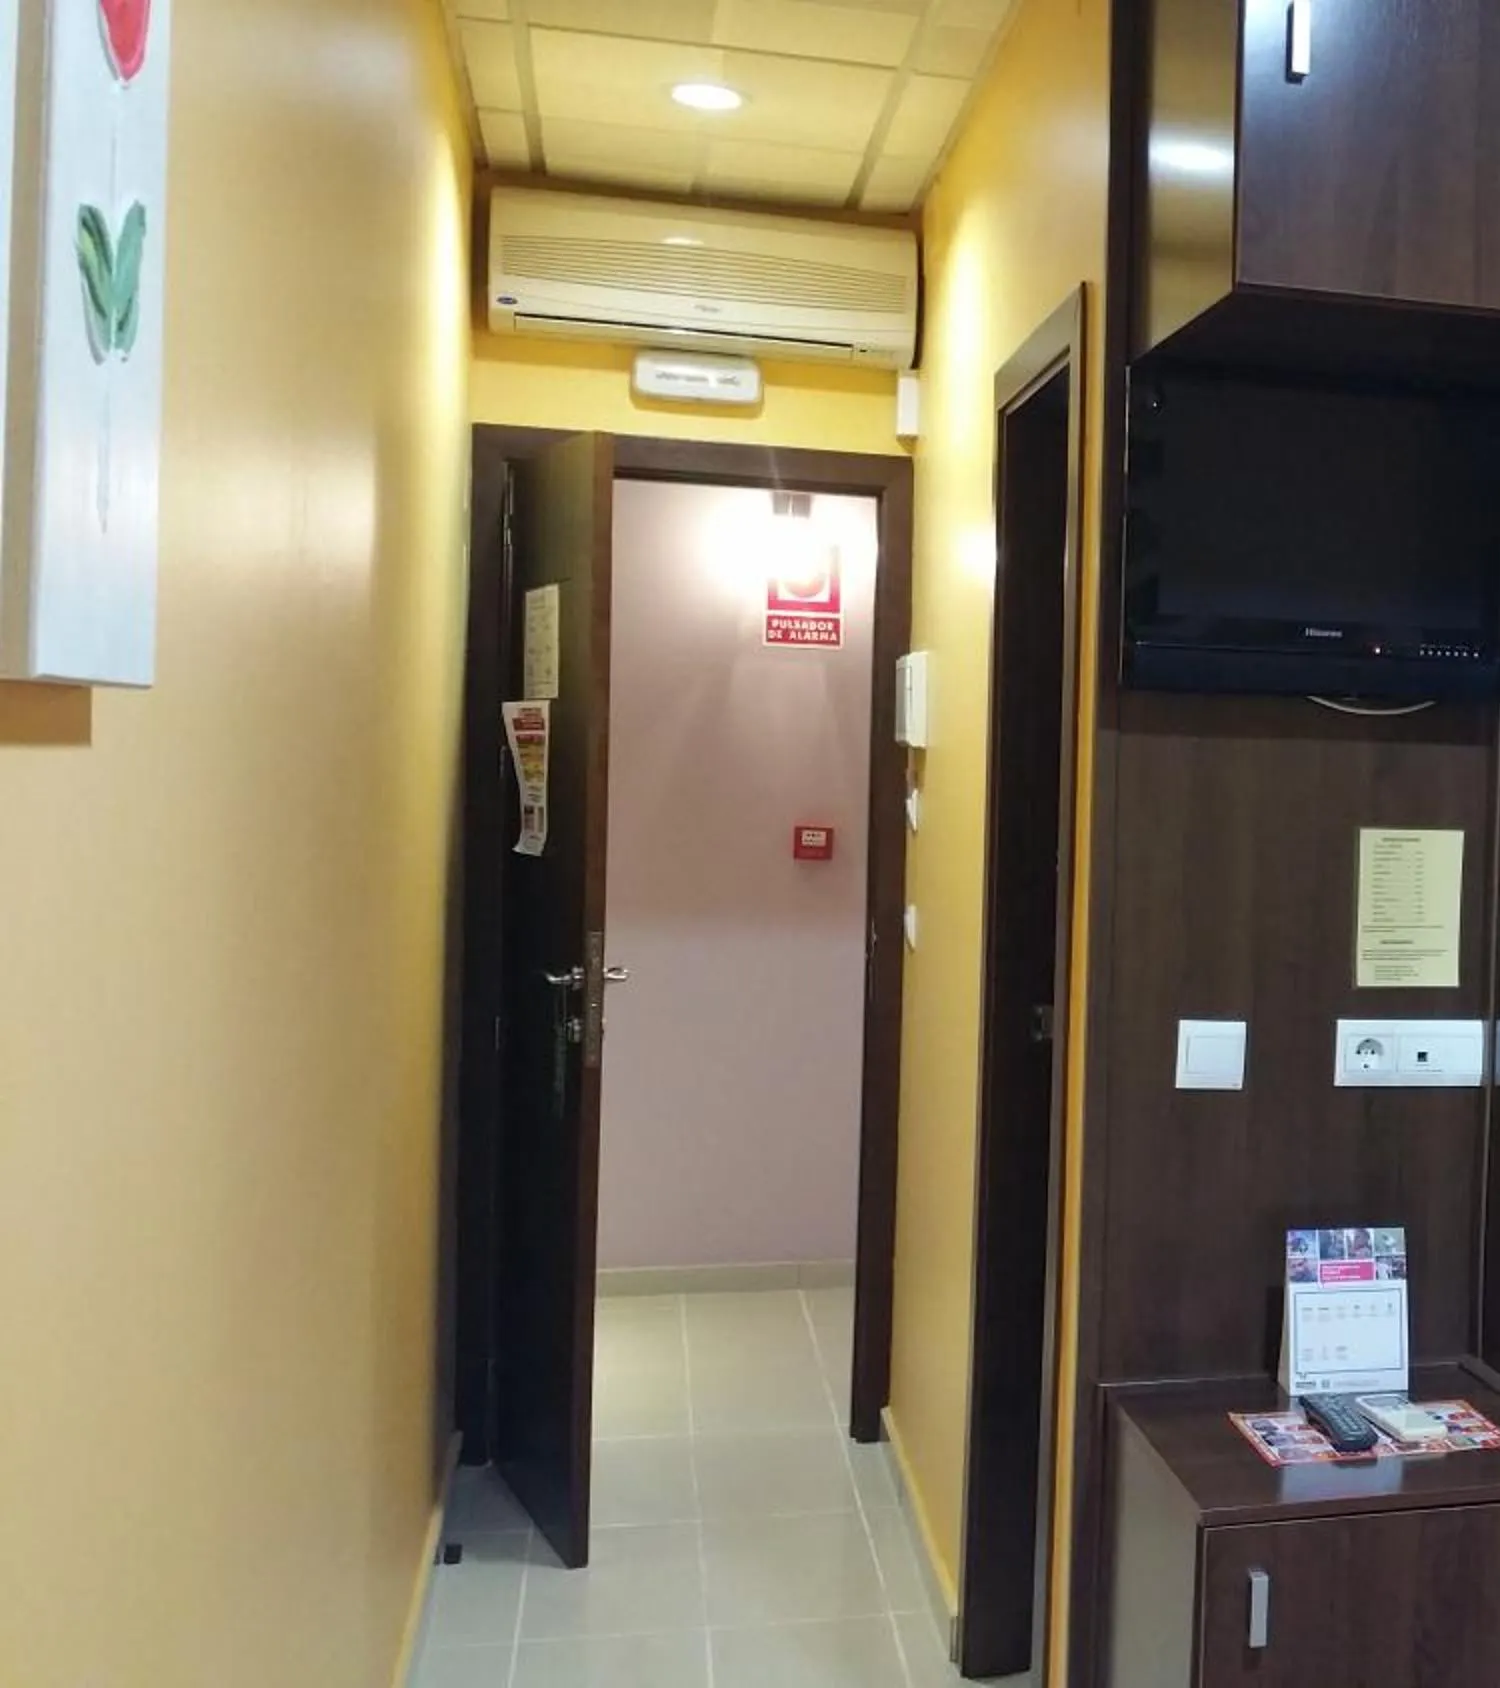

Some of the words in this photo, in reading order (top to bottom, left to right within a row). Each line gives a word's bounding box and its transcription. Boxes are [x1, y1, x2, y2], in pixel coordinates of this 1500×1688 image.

[771, 618, 834, 631] PULSADOR
[767, 629, 783, 639] DE
[789, 630, 838, 641] ALARMA
